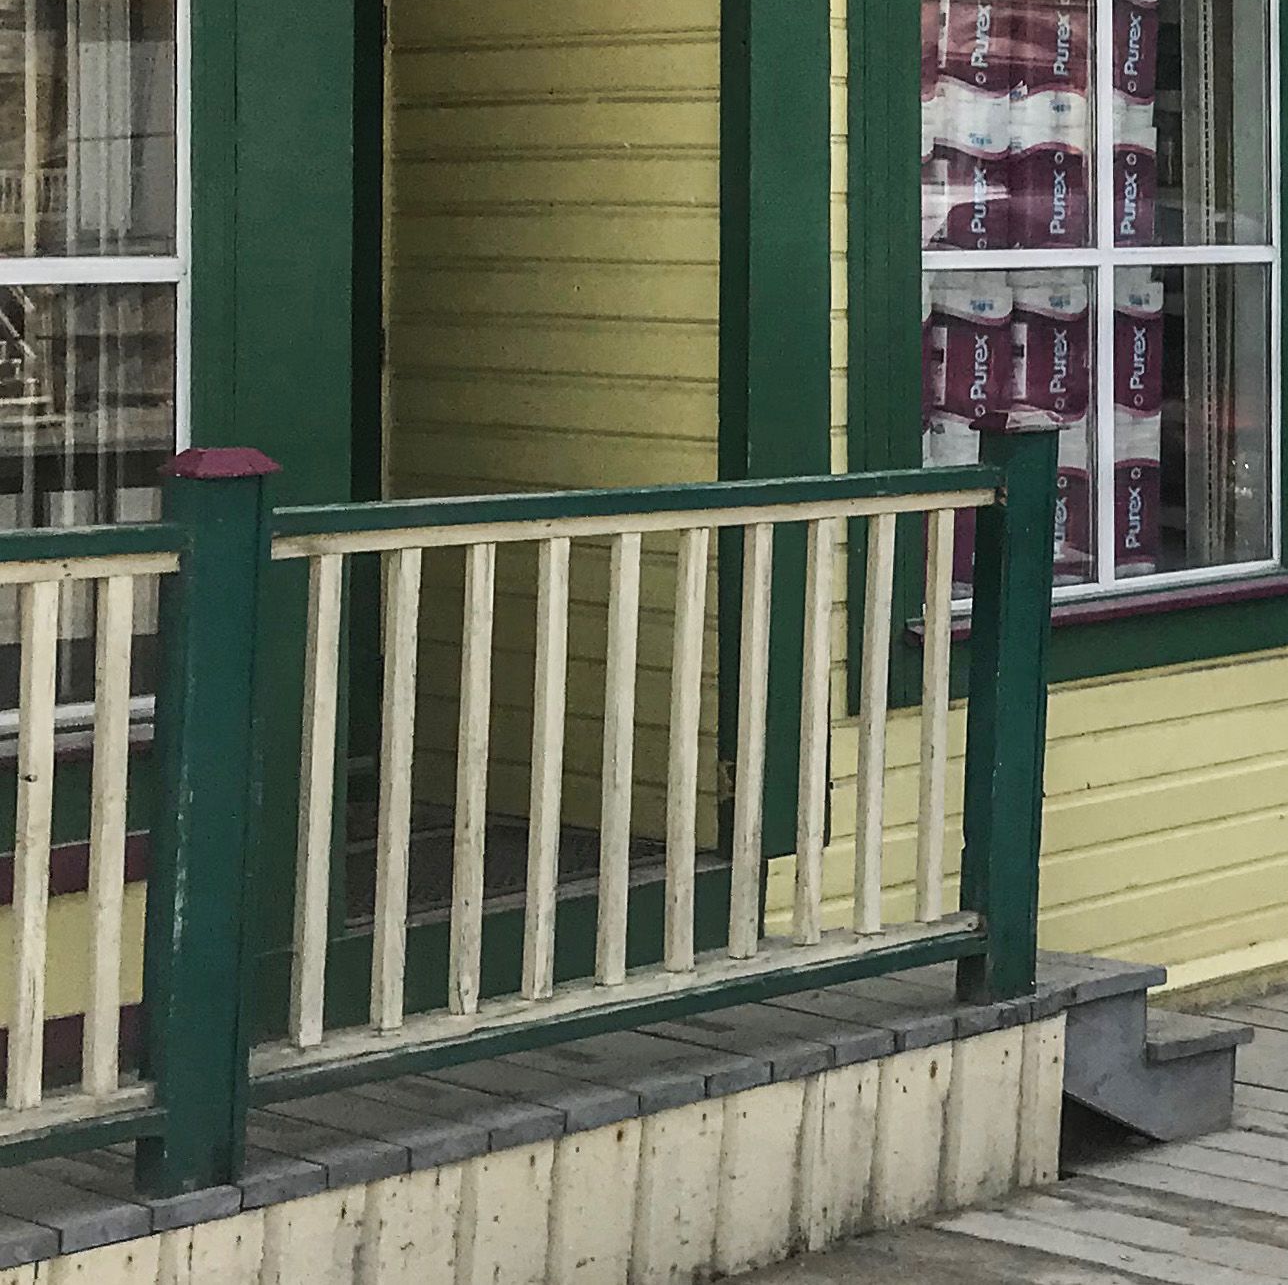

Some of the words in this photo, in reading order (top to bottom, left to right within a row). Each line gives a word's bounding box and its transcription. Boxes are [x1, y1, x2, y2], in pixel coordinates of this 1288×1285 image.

[971, 3, 993, 68] Purex
[1052, 10, 1072, 77] Purex
[1123, 11, 1143, 76] Purex
[971, 167, 988, 234] Purex
[1050, 168, 1068, 237] Purex
[1120, 172, 1138, 236] Purex
[970, 333, 990, 401] Purex
[1050, 328, 1069, 395] Purex
[1129, 326, 1148, 391] Purex
[1125, 486, 1142, 550] Purex
